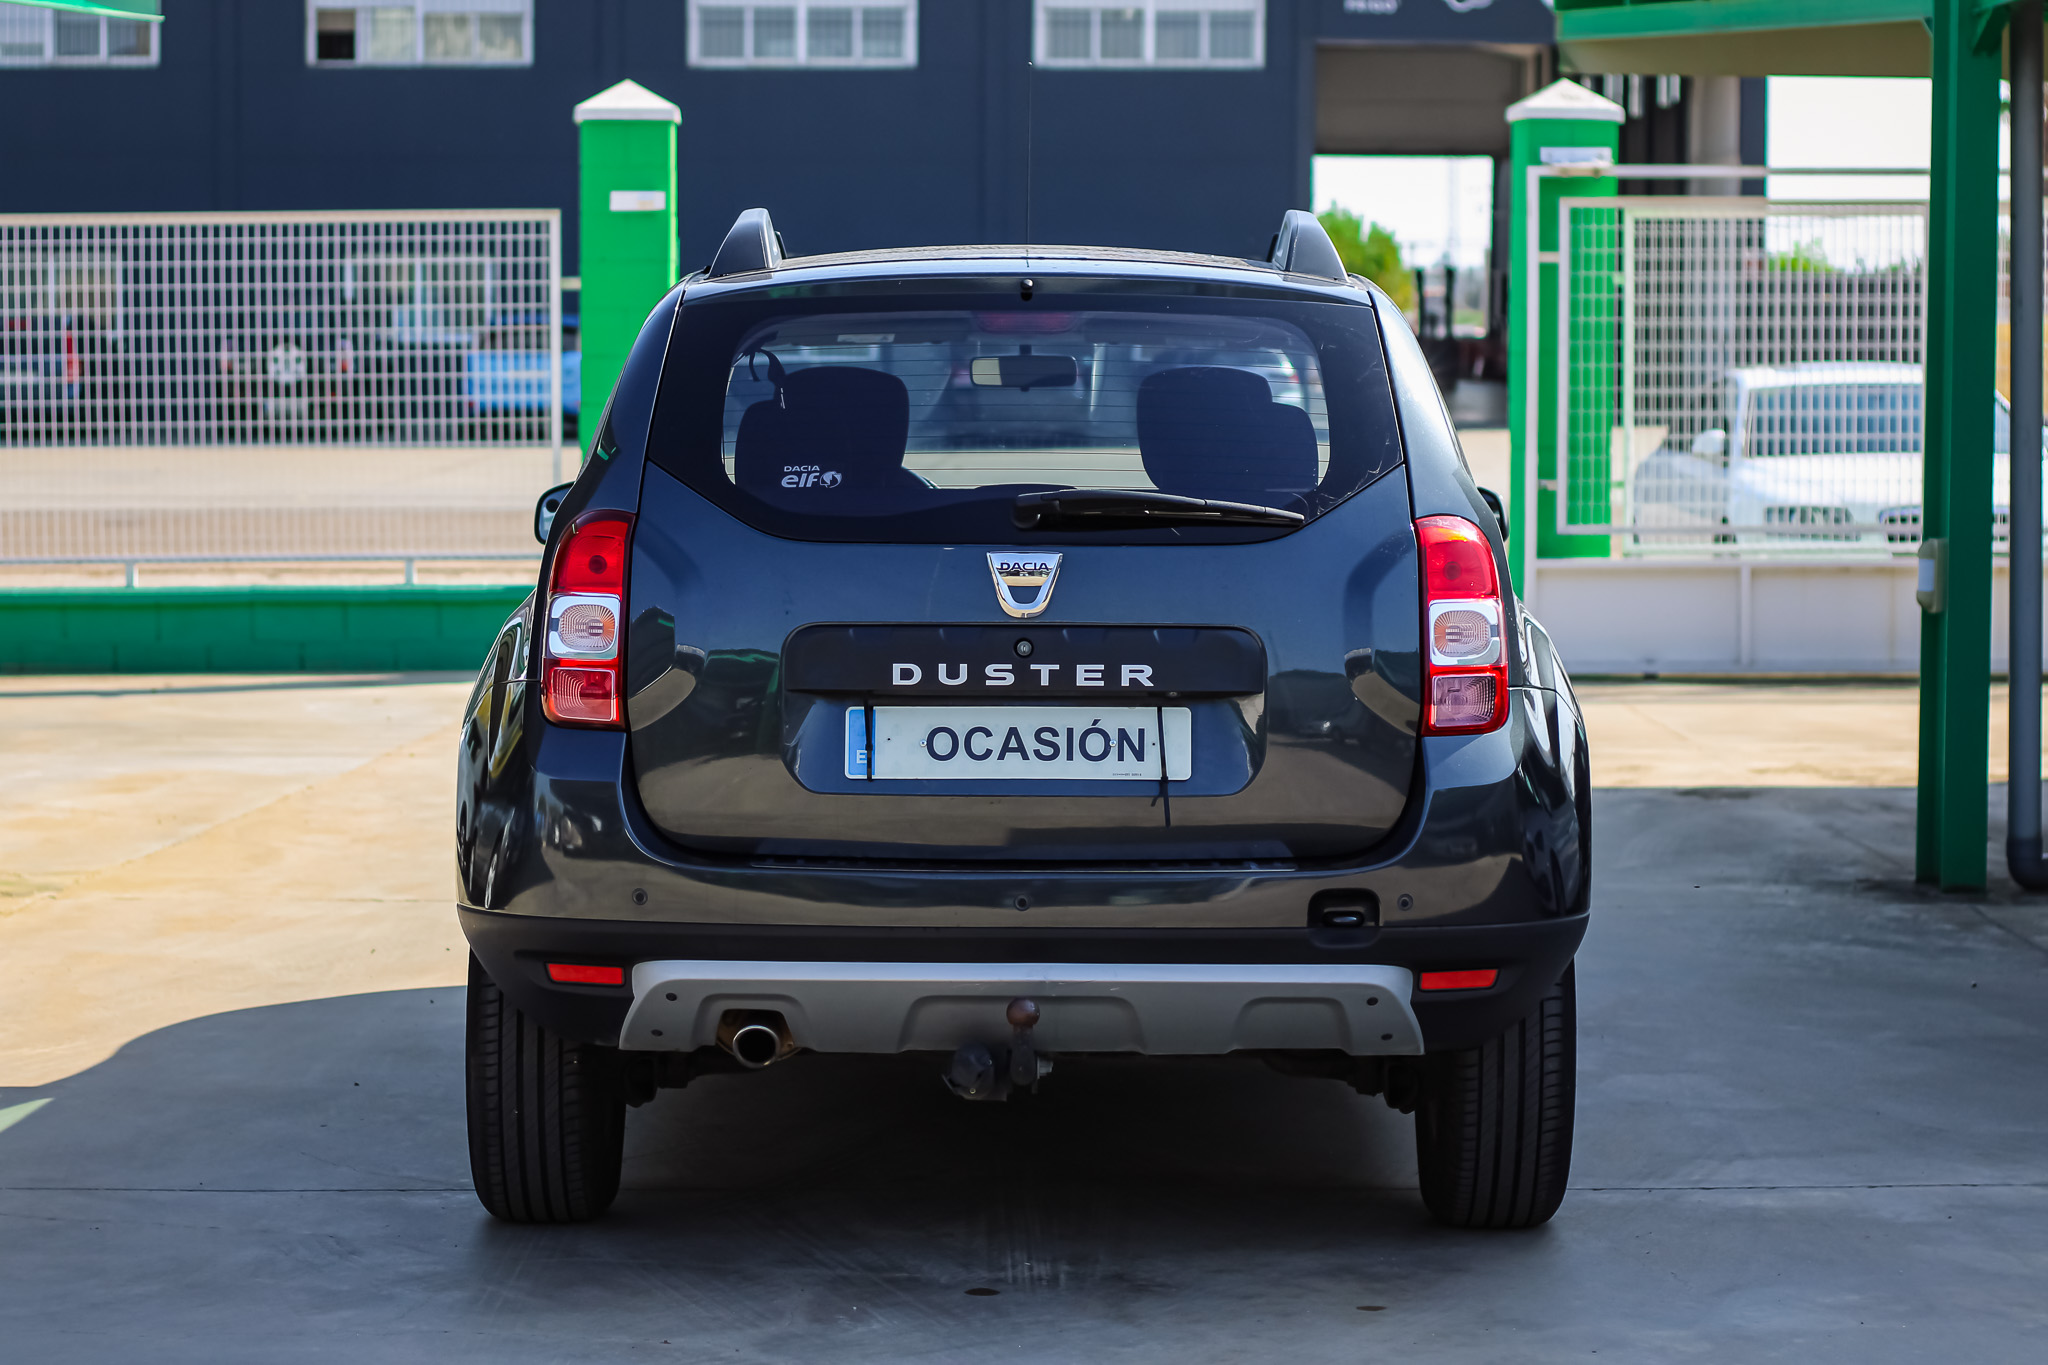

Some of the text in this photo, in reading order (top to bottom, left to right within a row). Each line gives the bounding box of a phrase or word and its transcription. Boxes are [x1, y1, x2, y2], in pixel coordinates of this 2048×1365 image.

[781, 472, 820, 488] elf
[1000, 562, 1049, 571] DACIA
[892, 663, 1154, 686] DUSTER
[926, 718, 1145, 762] OCASIÓN
[856, 749, 868, 764] E
